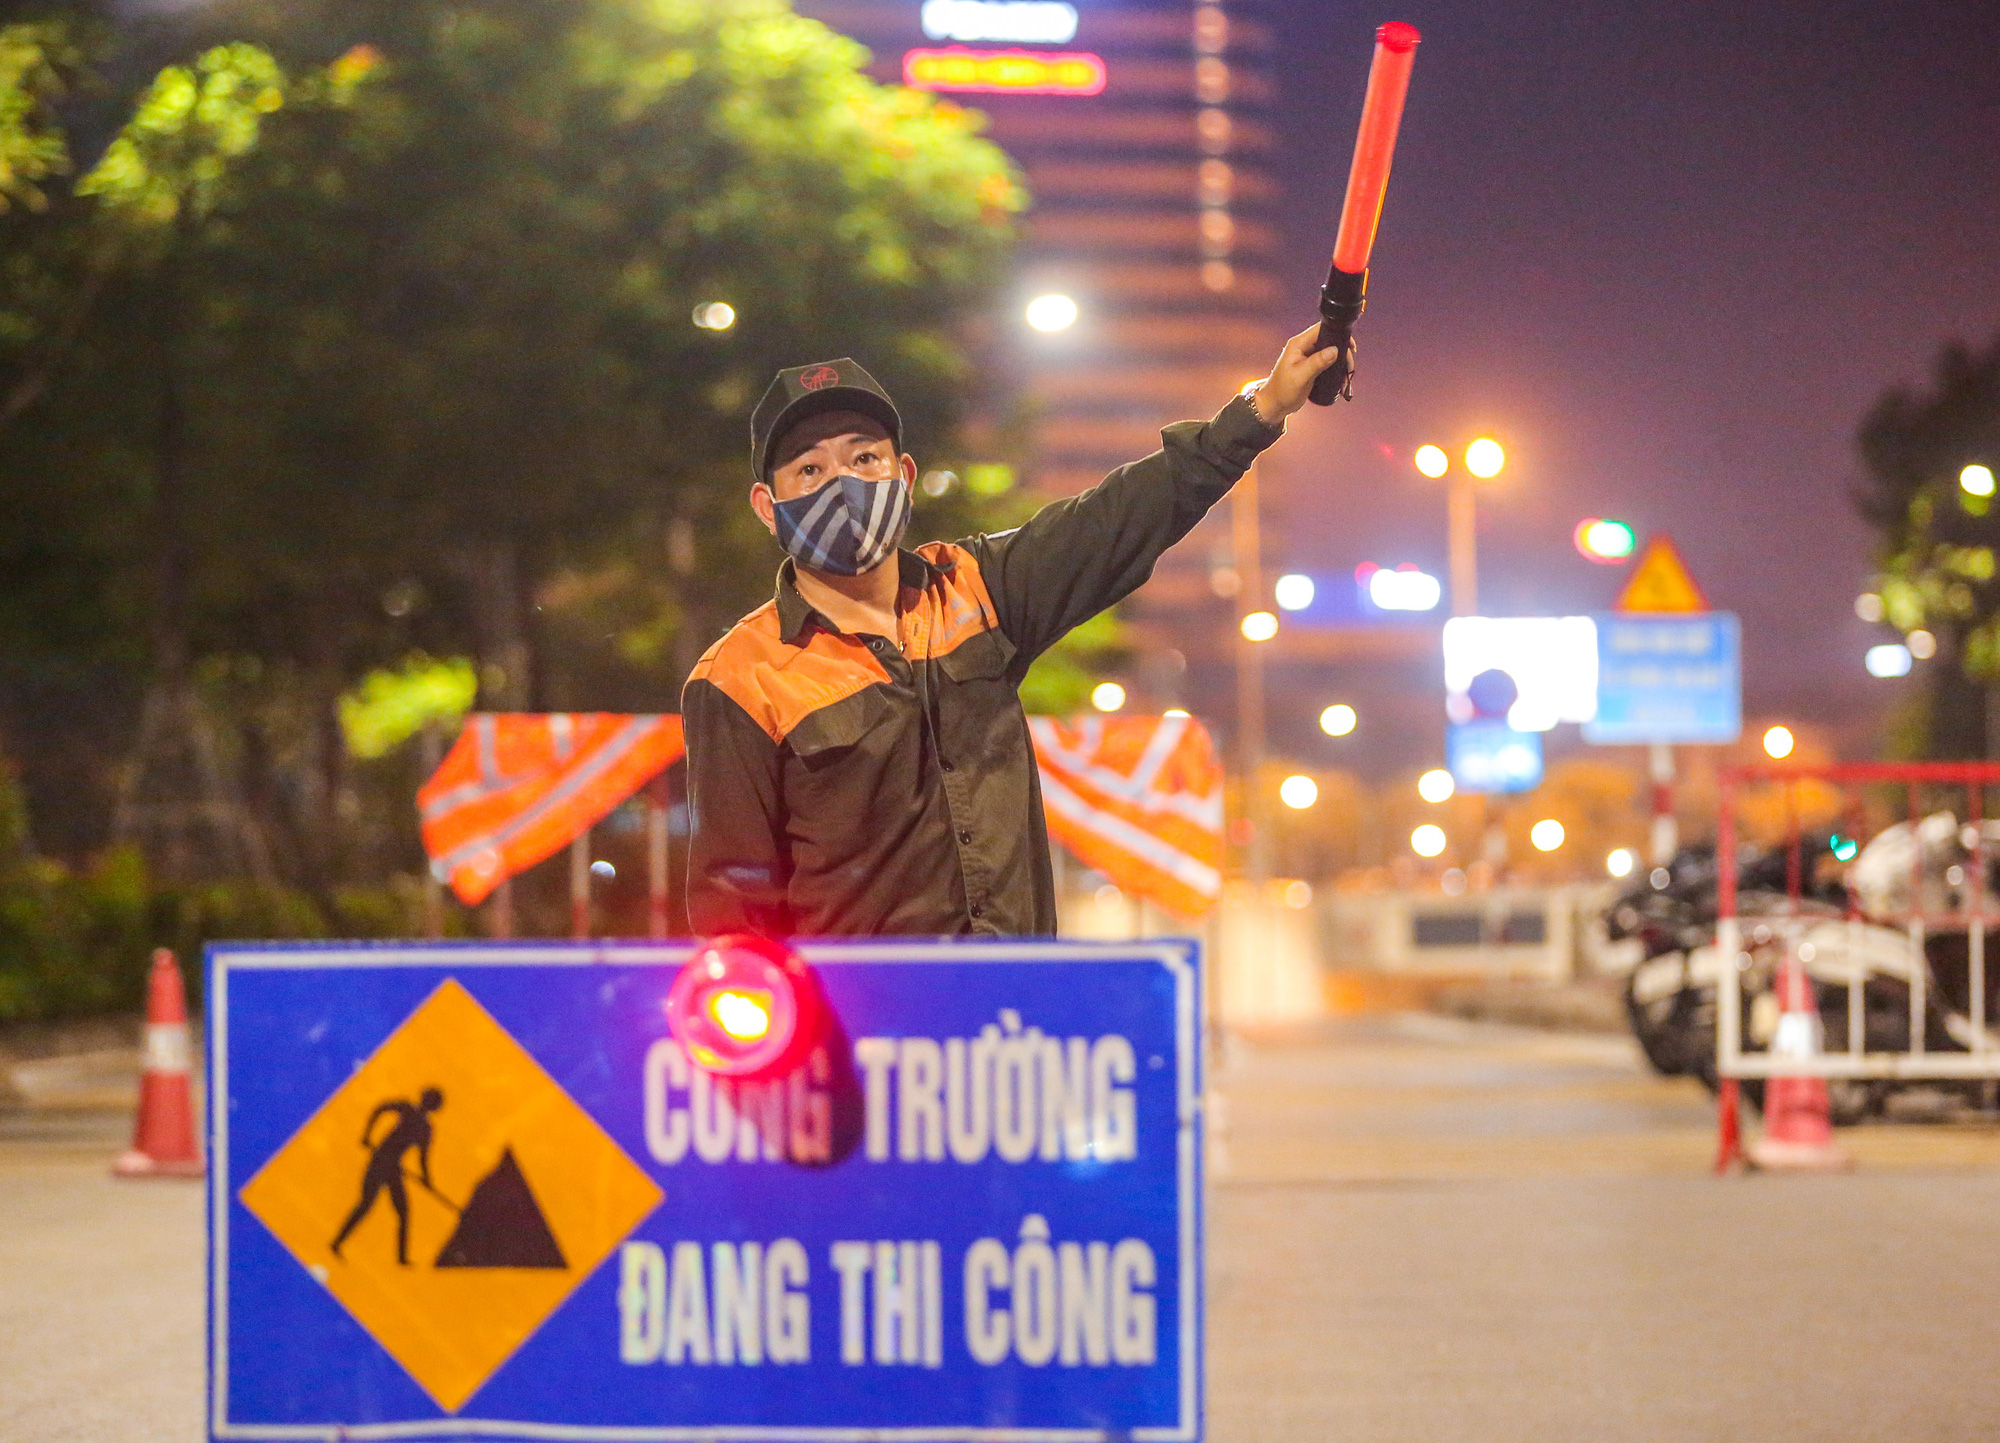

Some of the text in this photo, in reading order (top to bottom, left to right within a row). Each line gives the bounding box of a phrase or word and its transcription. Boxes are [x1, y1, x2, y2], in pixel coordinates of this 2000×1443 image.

[854, 1008, 1138, 1164] TRƯỜNG
[617, 1213, 1158, 1369] ĐANG THI CÔNG
